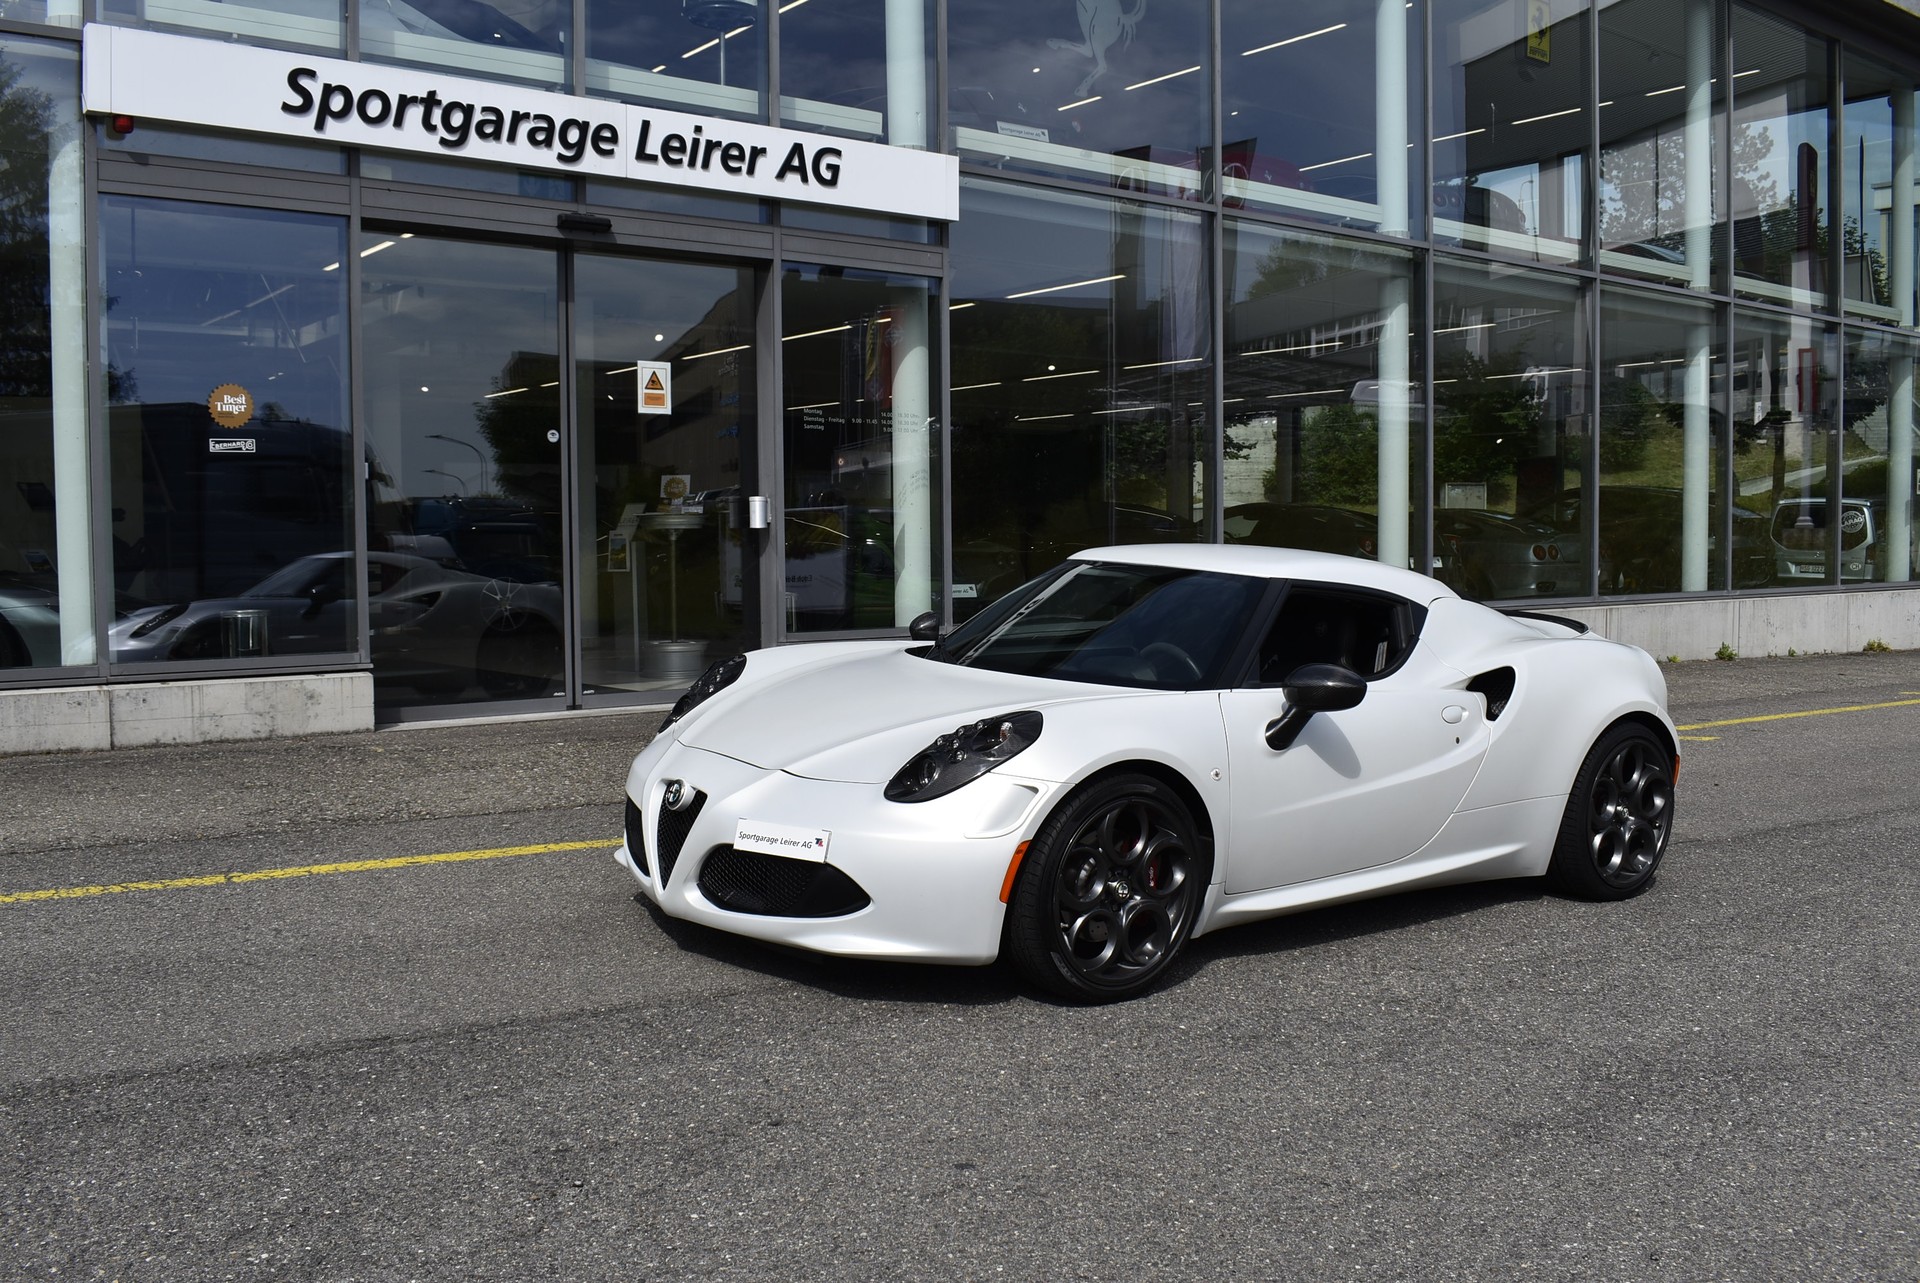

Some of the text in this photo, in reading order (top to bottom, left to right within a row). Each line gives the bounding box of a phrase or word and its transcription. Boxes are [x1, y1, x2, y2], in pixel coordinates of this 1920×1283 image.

[281, 67, 842, 188] Sportgarage Leirer AG
[223, 393, 246, 404] Best
[803, 415, 825, 423] Dienstag
[828, 416, 846, 424] Freitag
[803, 423, 825, 431] Samstag
[738, 831, 779, 846] Sportgarage
[779, 837, 801, 848] Leirer
[801, 840, 813, 850] AG
